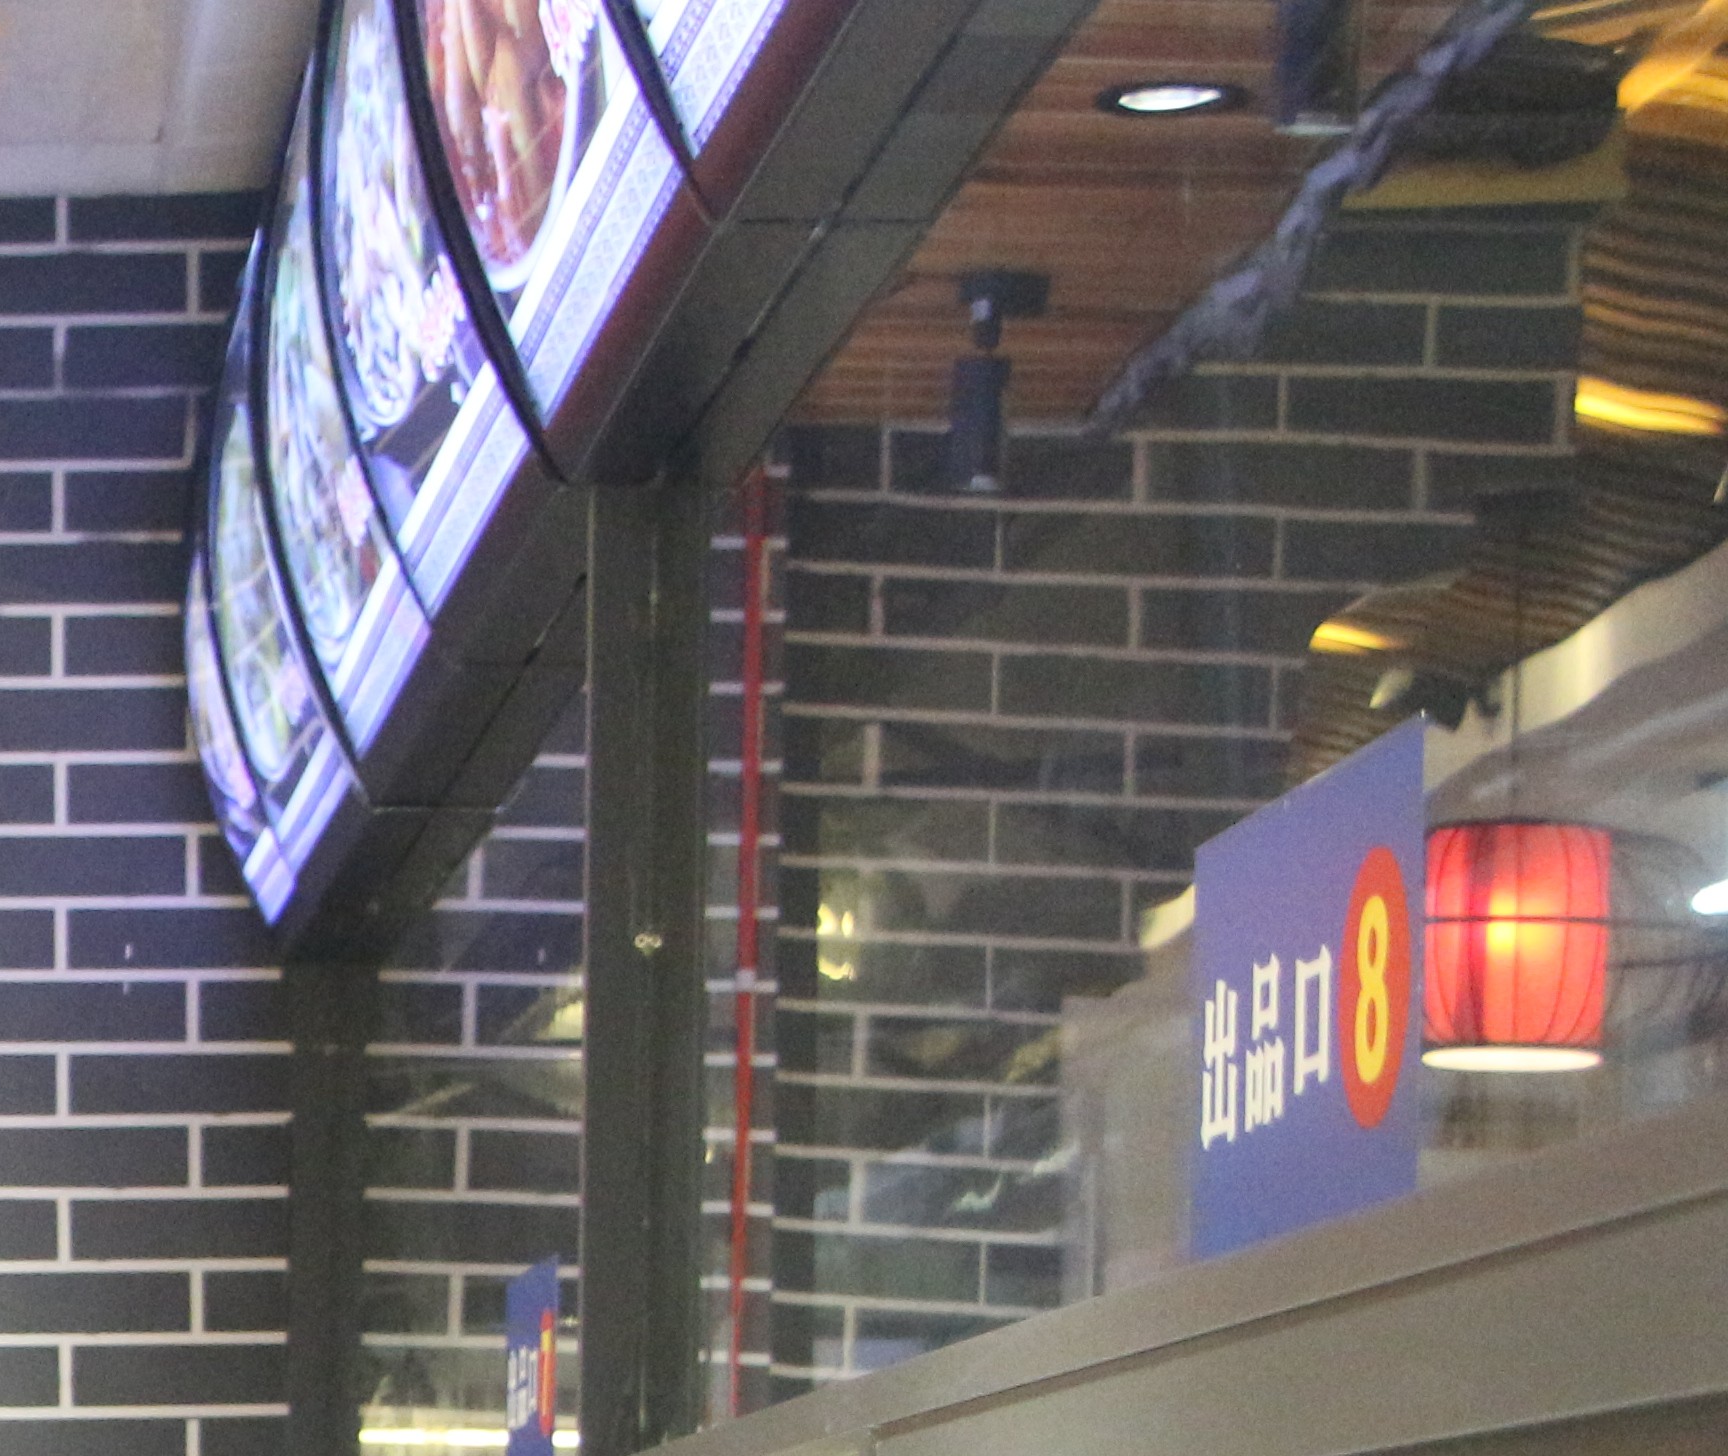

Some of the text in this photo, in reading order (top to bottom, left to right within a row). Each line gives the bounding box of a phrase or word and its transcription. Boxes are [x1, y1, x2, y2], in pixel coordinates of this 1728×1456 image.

[1200, 894, 1391, 1151] 出品口 8
